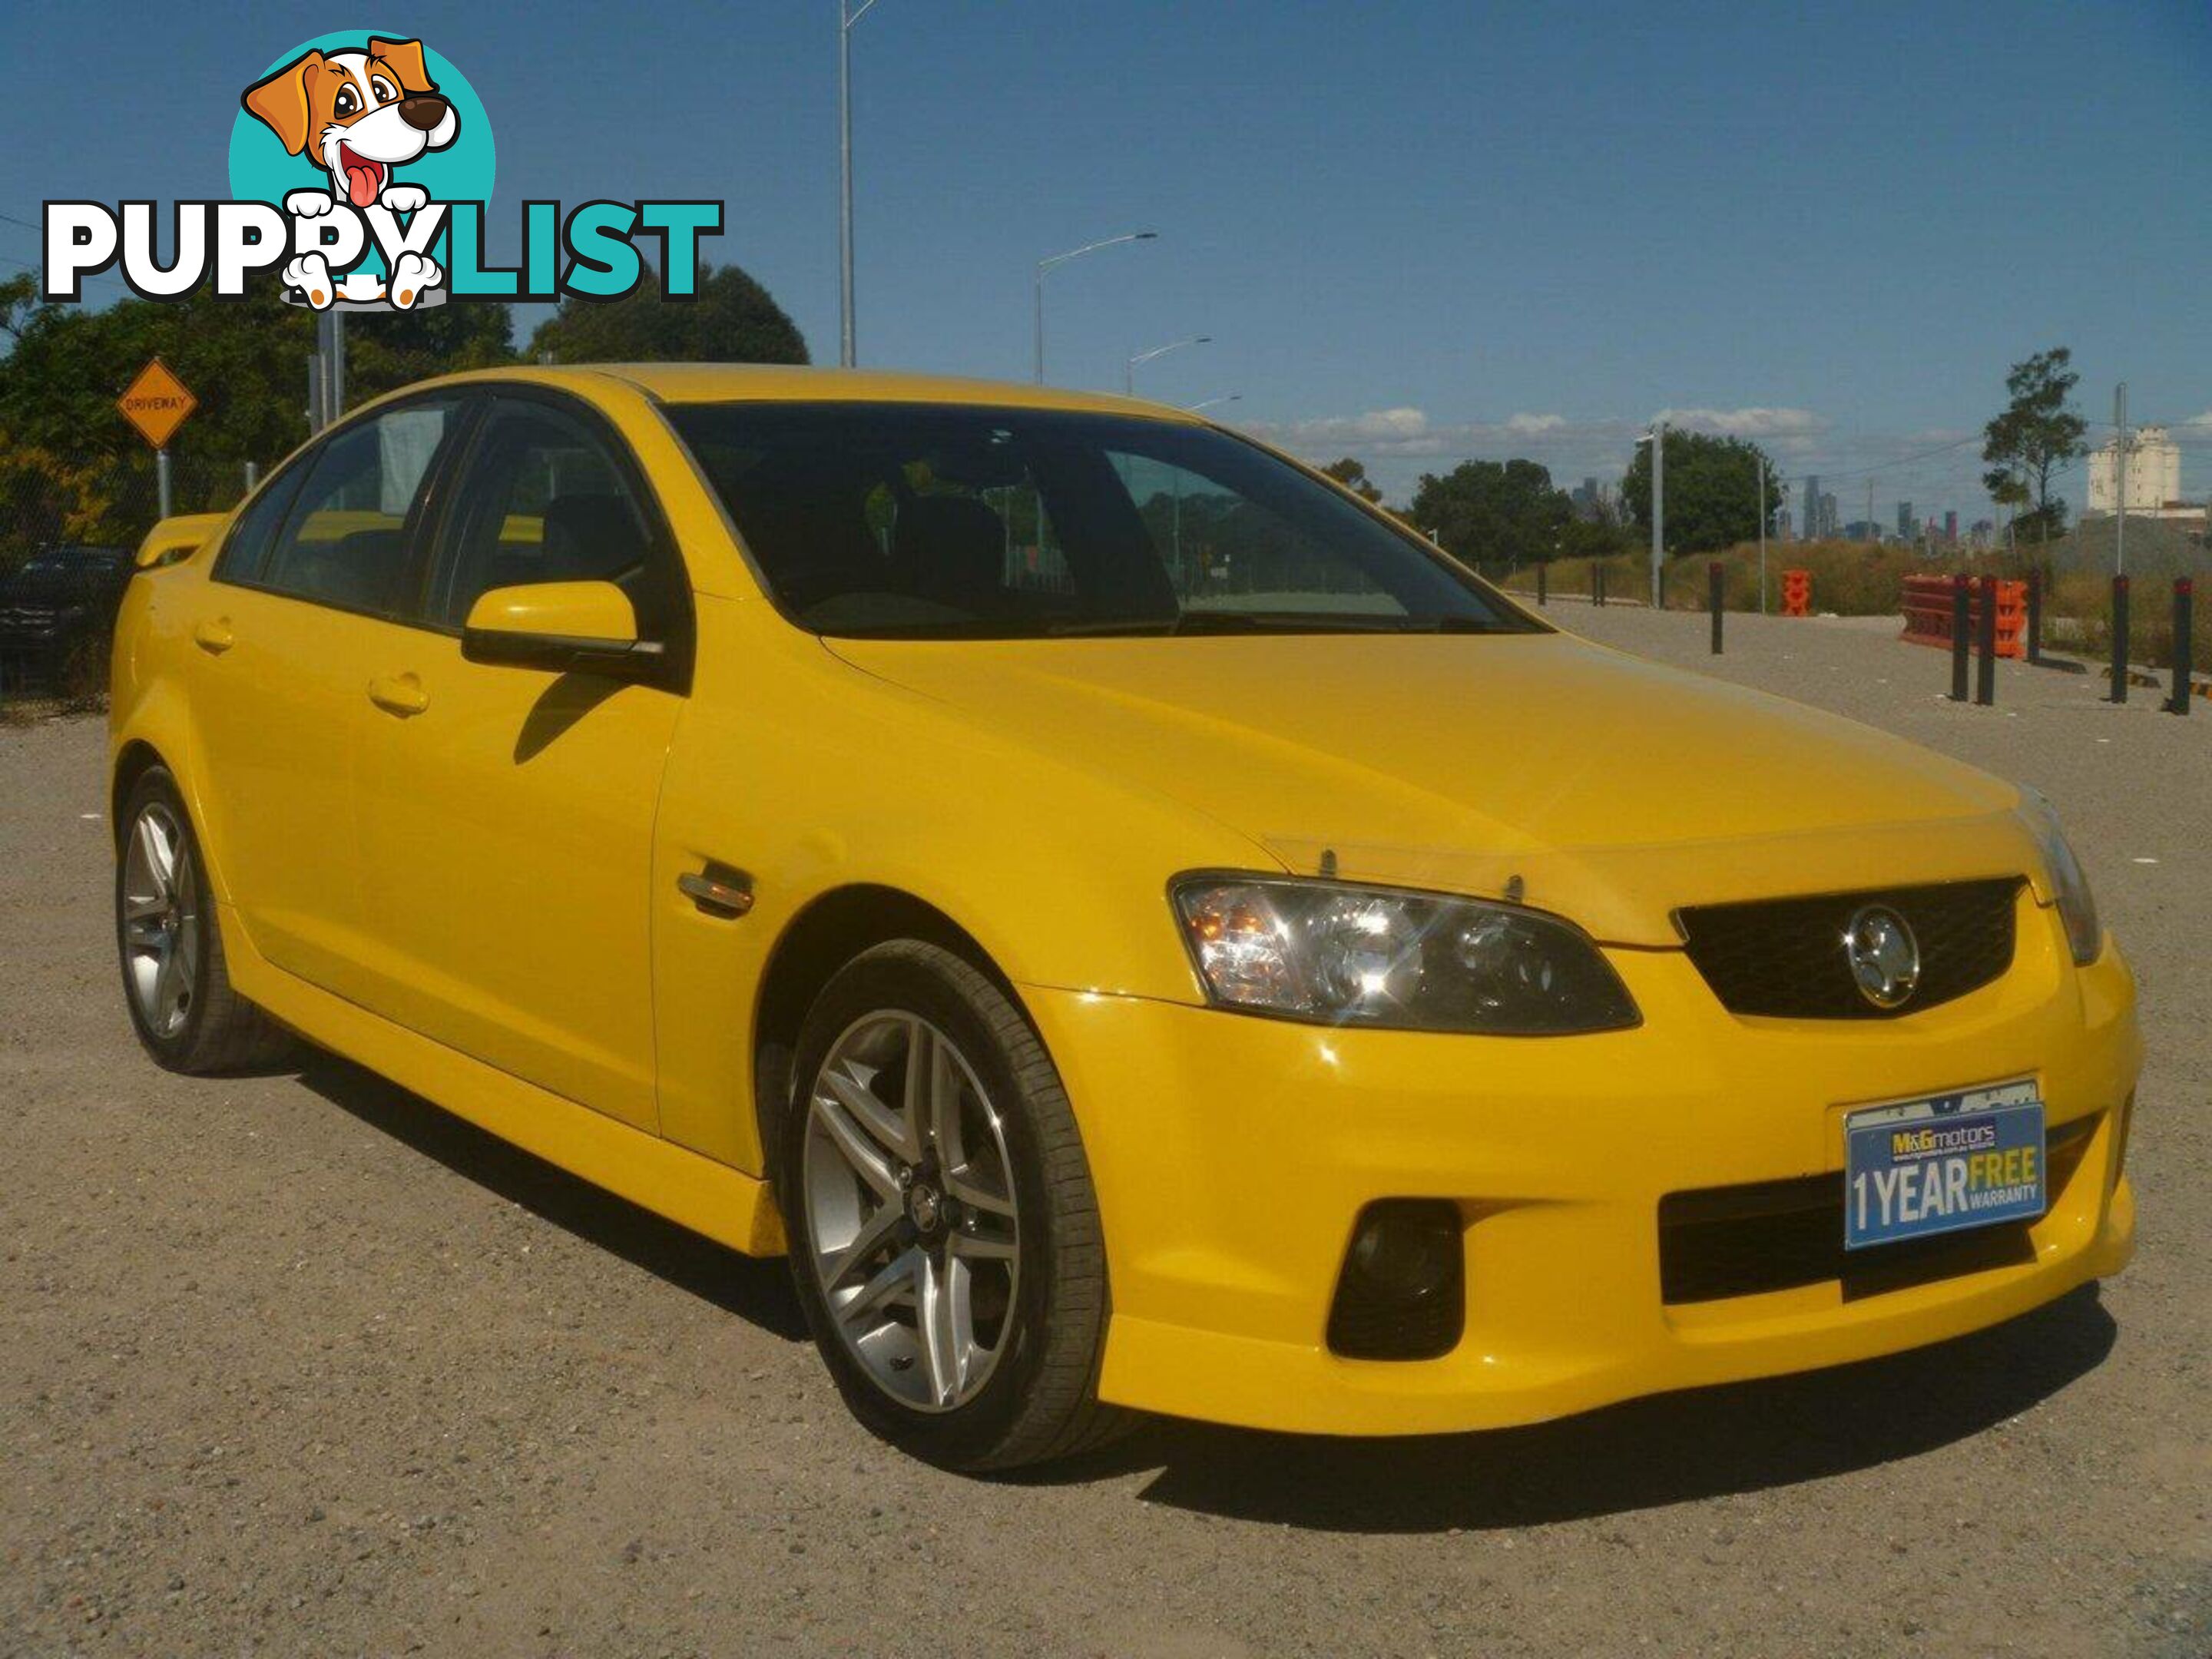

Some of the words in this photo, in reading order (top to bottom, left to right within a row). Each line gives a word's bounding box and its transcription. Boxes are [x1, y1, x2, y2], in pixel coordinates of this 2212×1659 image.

[125, 397, 185, 411] DRIVEWAY
[1853, 1171, 1866, 1230] 1
[1873, 1158, 1969, 1227] YEAR
[1968, 1147, 2036, 1190] FREE
[1969, 1184, 2037, 1210] WARRANTY
